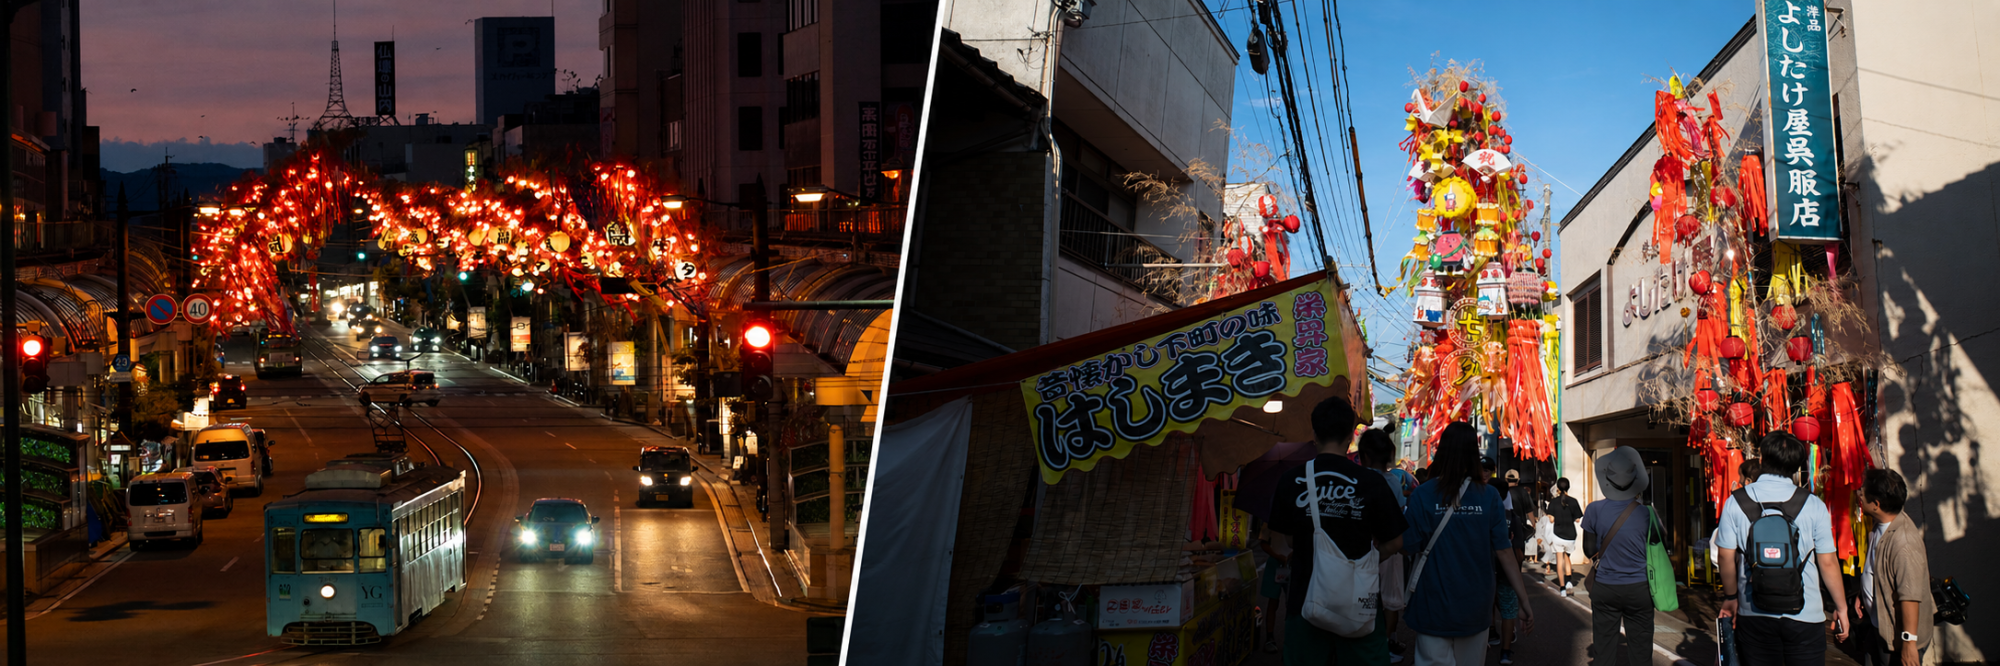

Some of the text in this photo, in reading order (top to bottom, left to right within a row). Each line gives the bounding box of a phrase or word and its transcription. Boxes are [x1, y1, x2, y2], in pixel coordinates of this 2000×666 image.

[1806, 5, 1821, 31] 洋品
[1777, 1, 1821, 227] よしたけ屋呉服店
[189, 302, 208, 317] 40
[1036, 301, 1282, 402] 昔懐かし下町の味
[1033, 329, 1288, 472] はしまき
